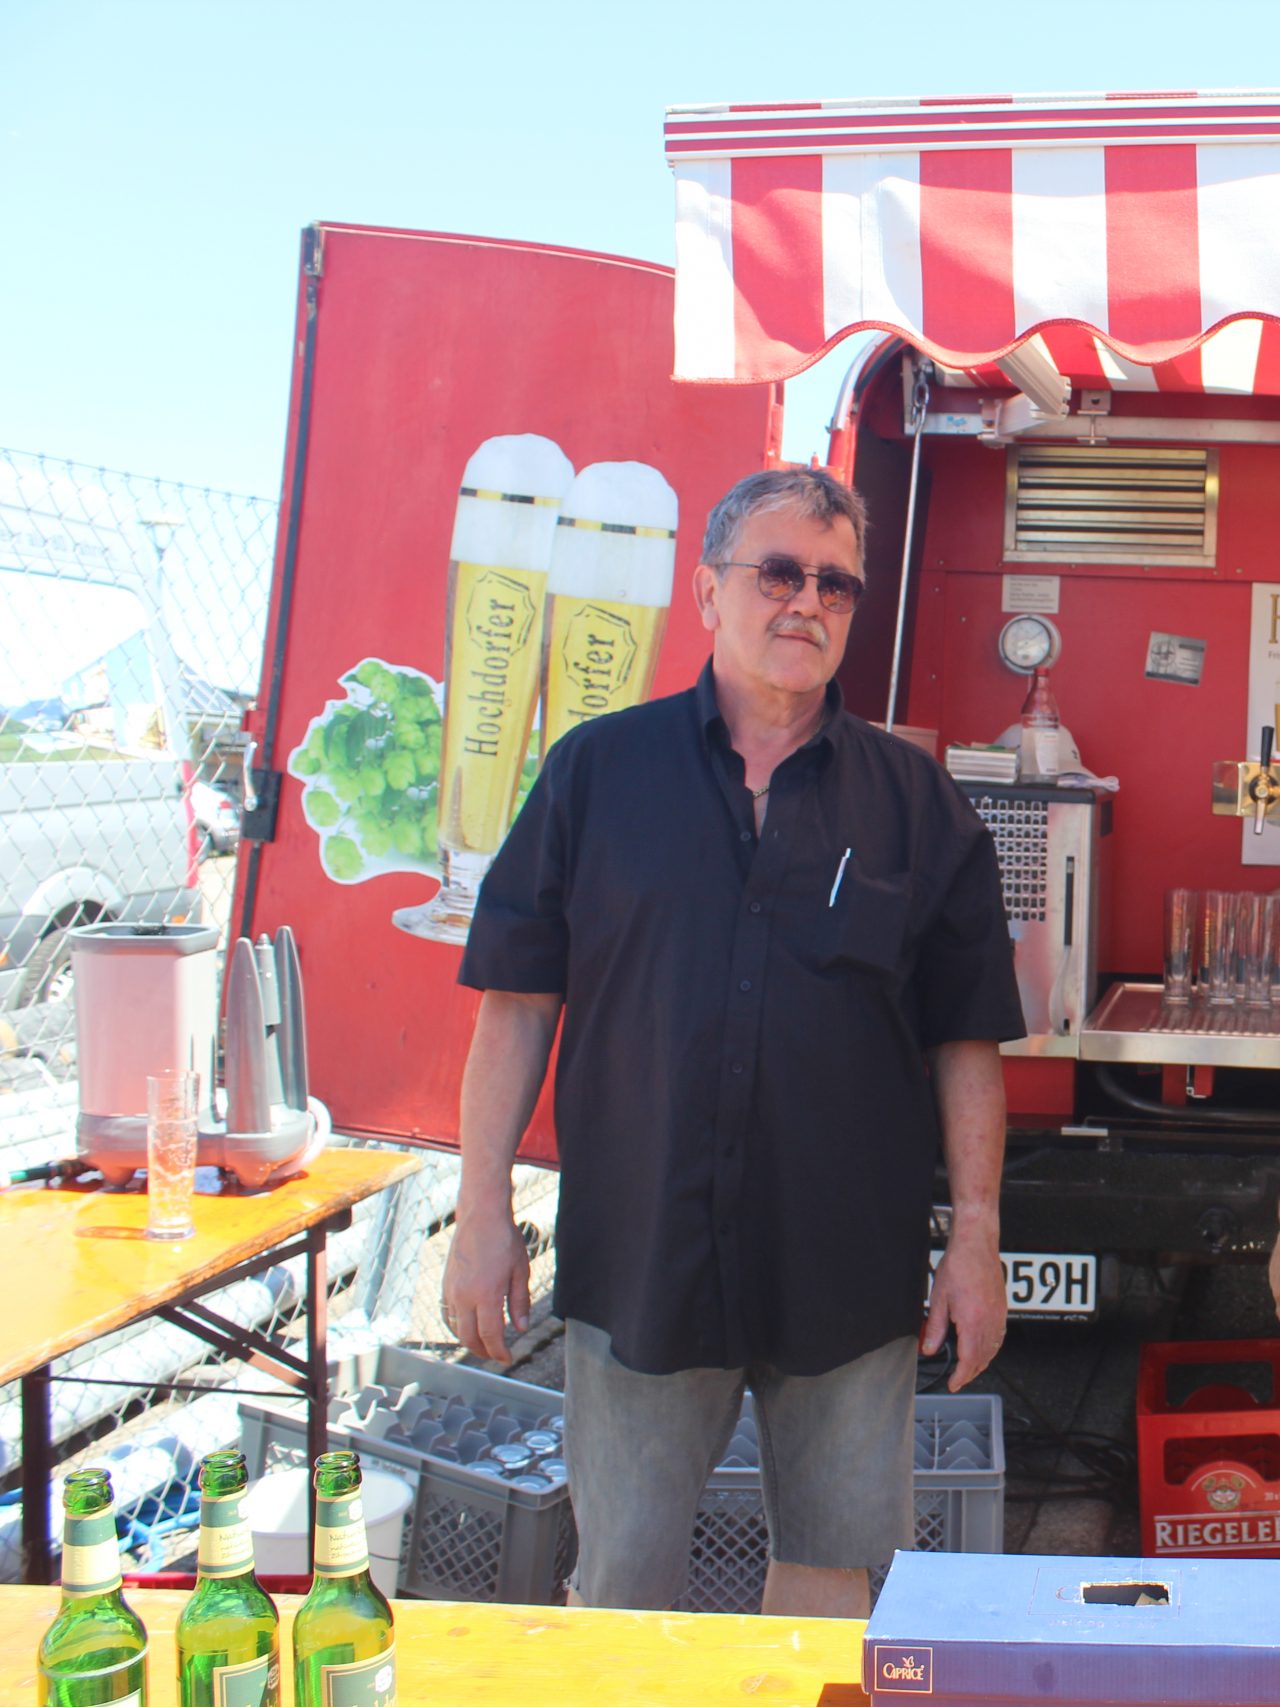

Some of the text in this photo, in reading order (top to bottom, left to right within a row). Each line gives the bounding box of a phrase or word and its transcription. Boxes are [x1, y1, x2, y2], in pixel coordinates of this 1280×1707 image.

[464, 598, 515, 758] Hochdorfer
[567, 633, 615, 722] dorfer
[1001, 1261, 1090, 1306] 59H
[882, 1662, 924, 1681] CAPRICE
